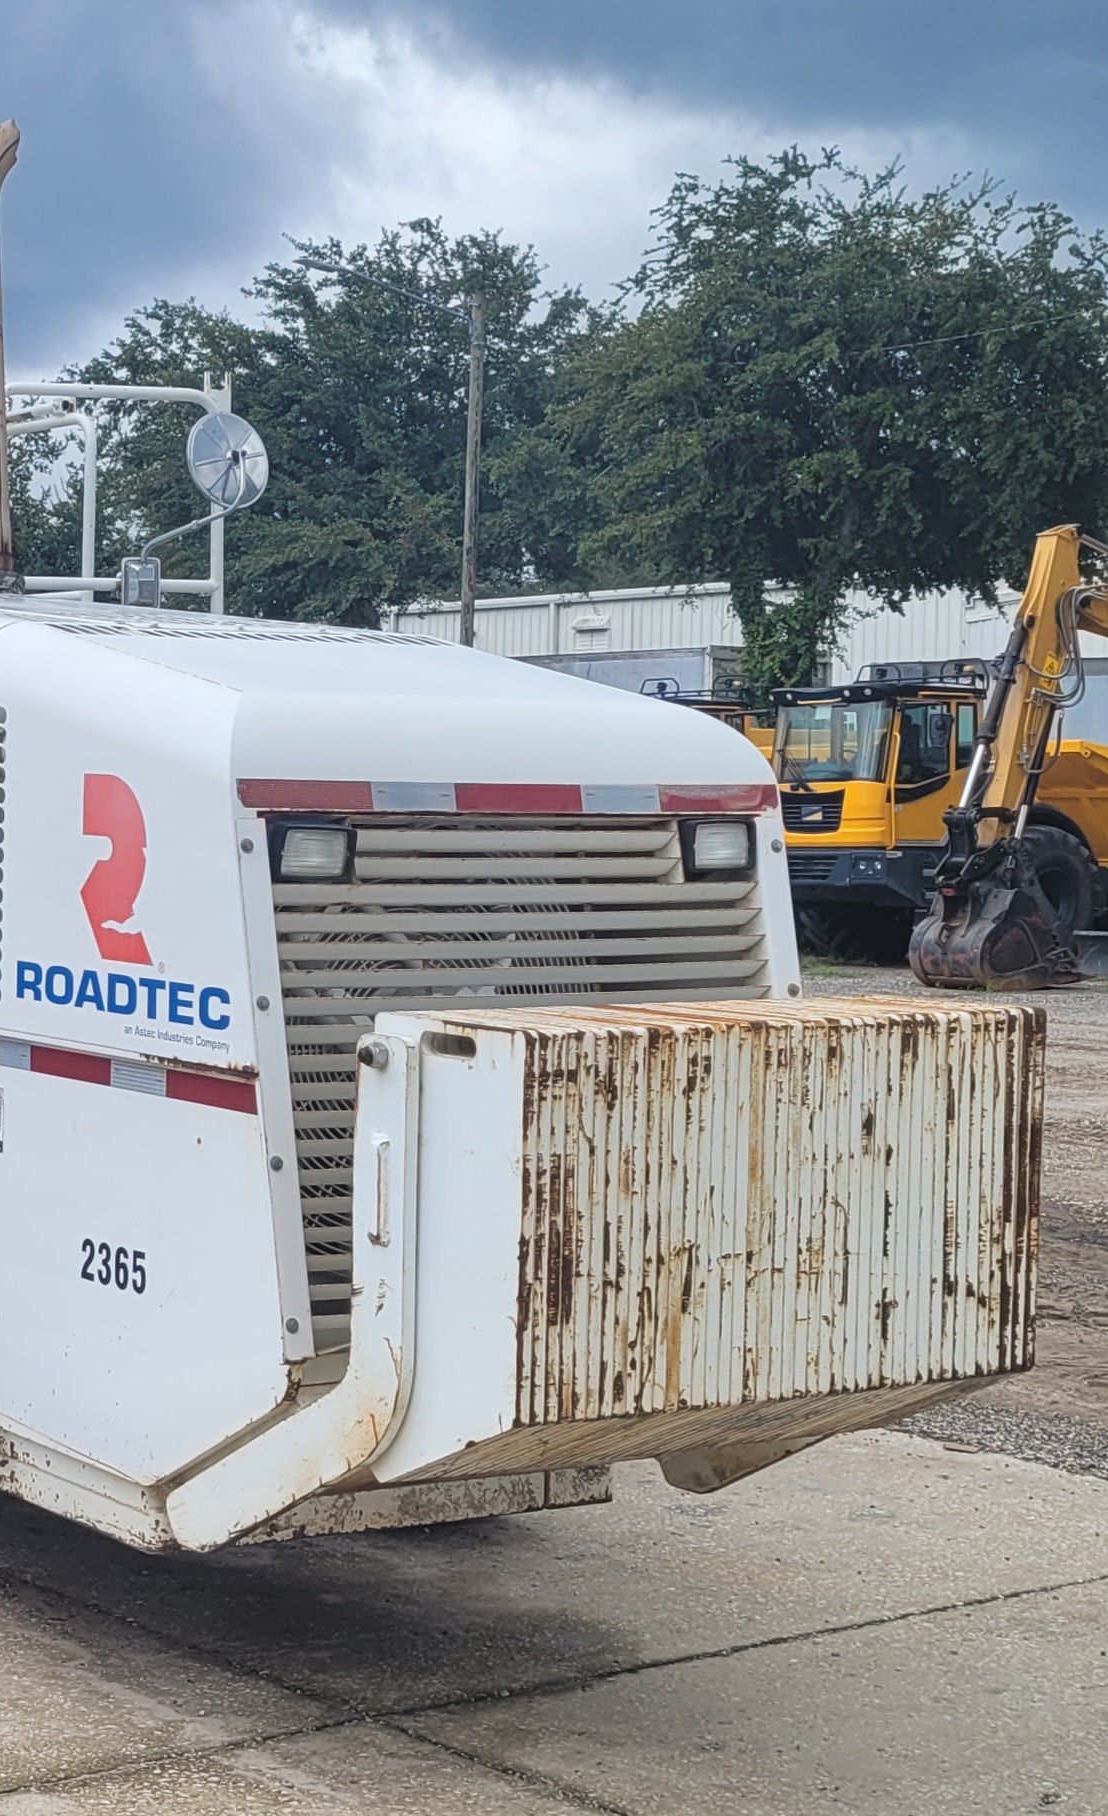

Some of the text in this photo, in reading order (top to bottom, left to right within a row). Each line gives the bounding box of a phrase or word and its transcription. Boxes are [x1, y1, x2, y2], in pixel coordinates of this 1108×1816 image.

[16, 960, 230, 1030] ROADTEC
[124, 1025, 230, 1054] an Astec Industries Company
[81, 1238, 146, 1294] 2365
